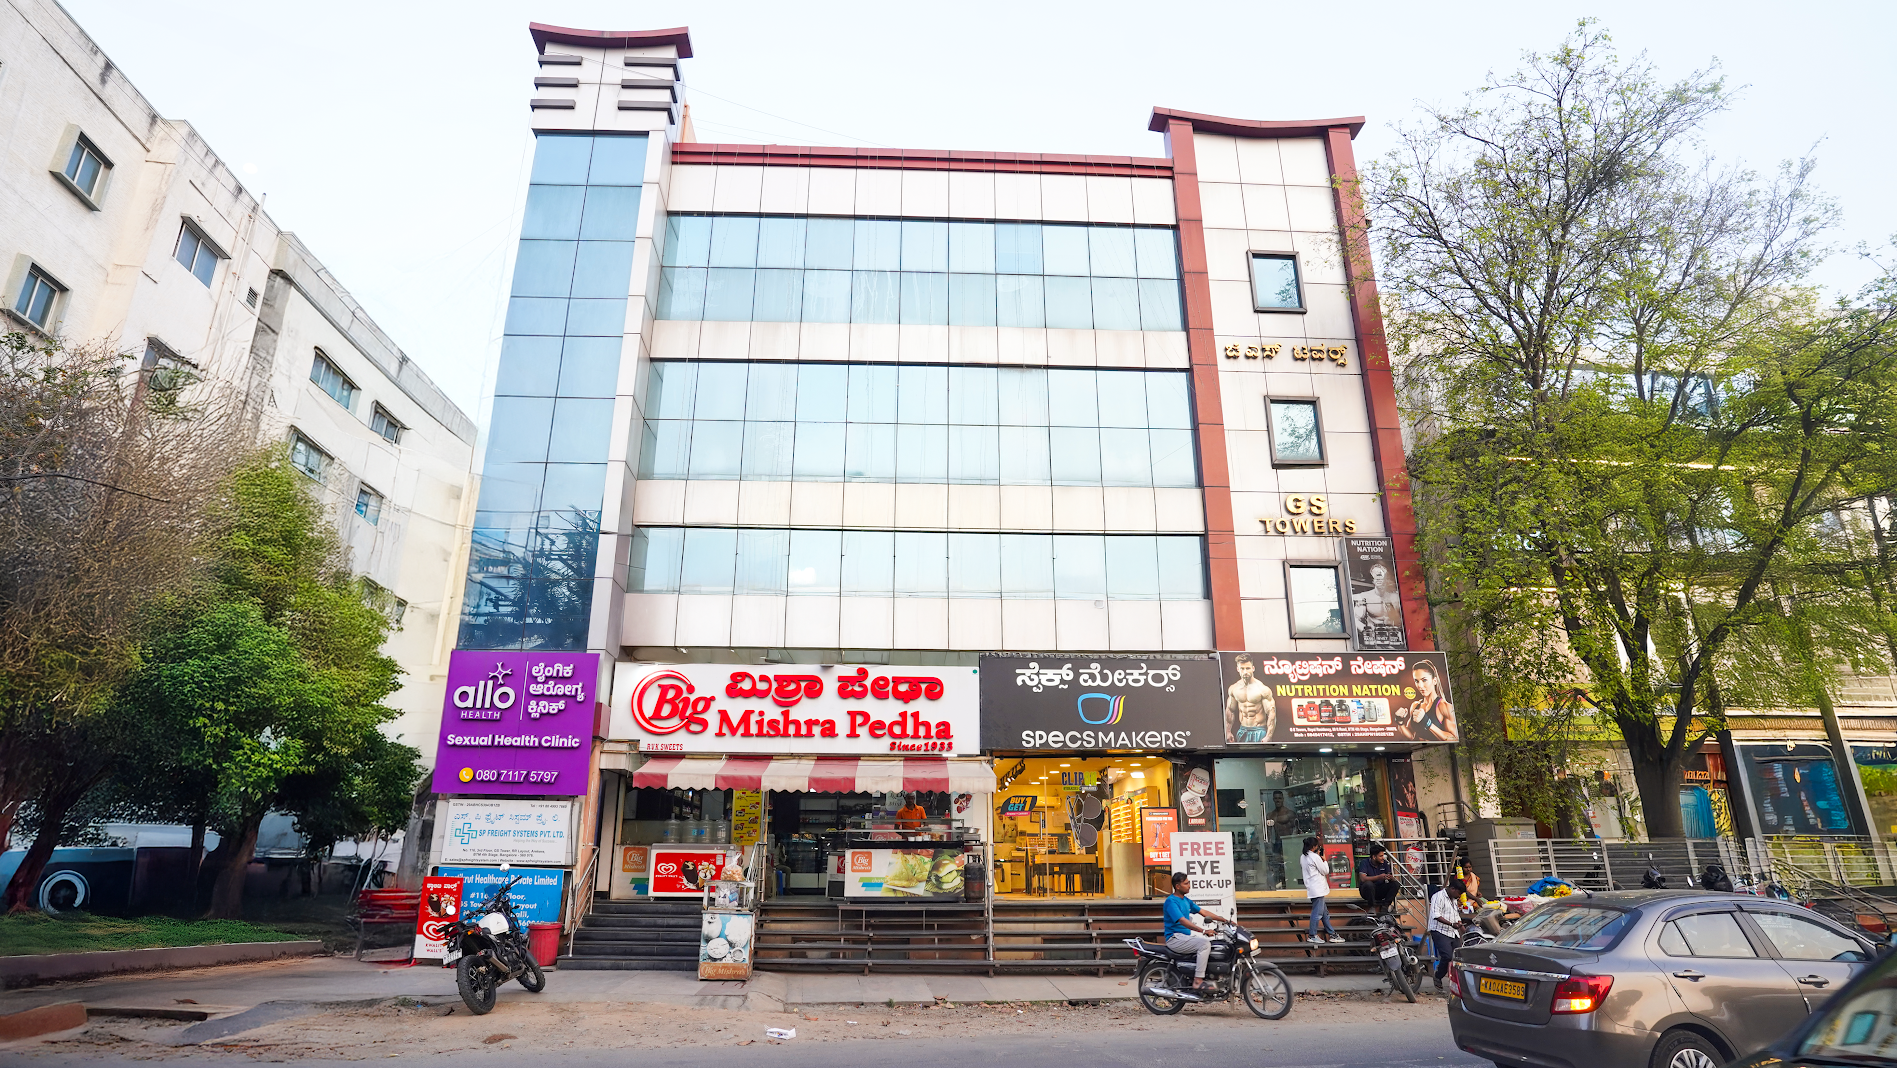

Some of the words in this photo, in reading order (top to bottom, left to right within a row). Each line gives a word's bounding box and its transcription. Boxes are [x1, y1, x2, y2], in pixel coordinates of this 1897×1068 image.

[1286, 494, 1328, 515] GS
[1259, 518, 1357, 534] TOWERS
[532, 662, 574, 682] ಲೈಂಗಿಕ
[1079, 662, 1181, 692] ಮೇಕರ್ಸ್
[1263, 656, 1343, 683] ನ್ಯೂಟ್ರಿಷನ್
[1350, 656, 1406, 678] ನೇಷನ್
[453, 680, 516, 709] allo
[529, 681, 585, 702] ಆರೋಗ್ಯ
[726, 672, 824, 707] ಮಿಶ್ರಾ
[838, 667, 944, 704] ಪೇಢಾ
[1276, 684, 1349, 696] NUTRITION
[1352, 684, 1401, 696] NATION
[460, 711, 501, 720] HEALTH
[528, 700, 566, 719] ಕ್ಲಿನಿಕ್
[648, 683, 716, 734] Big
[715, 709, 838, 738] Mishra
[846, 710, 954, 739] Pedha
[447, 734, 492, 746] Sexual
[494, 734, 538, 747] Health
[542, 735, 580, 748] Clinic
[476, 770, 497, 782] 080
[500, 770, 527, 782] 7117
[530, 771, 558, 782] 5797
[1024, 797, 1032, 811] 1
[1179, 841, 1225, 856] FREE
[630, 853, 644, 864] Big
[858, 856, 869, 866] Big
[1186, 861, 1220, 875] EYE
[475, 874, 509, 884] Healthcare
[534, 875, 558, 885] Limited
[1190, 880, 1232, 889] ECK-UP
[1484, 981, 1524, 997] KA04AE3589
